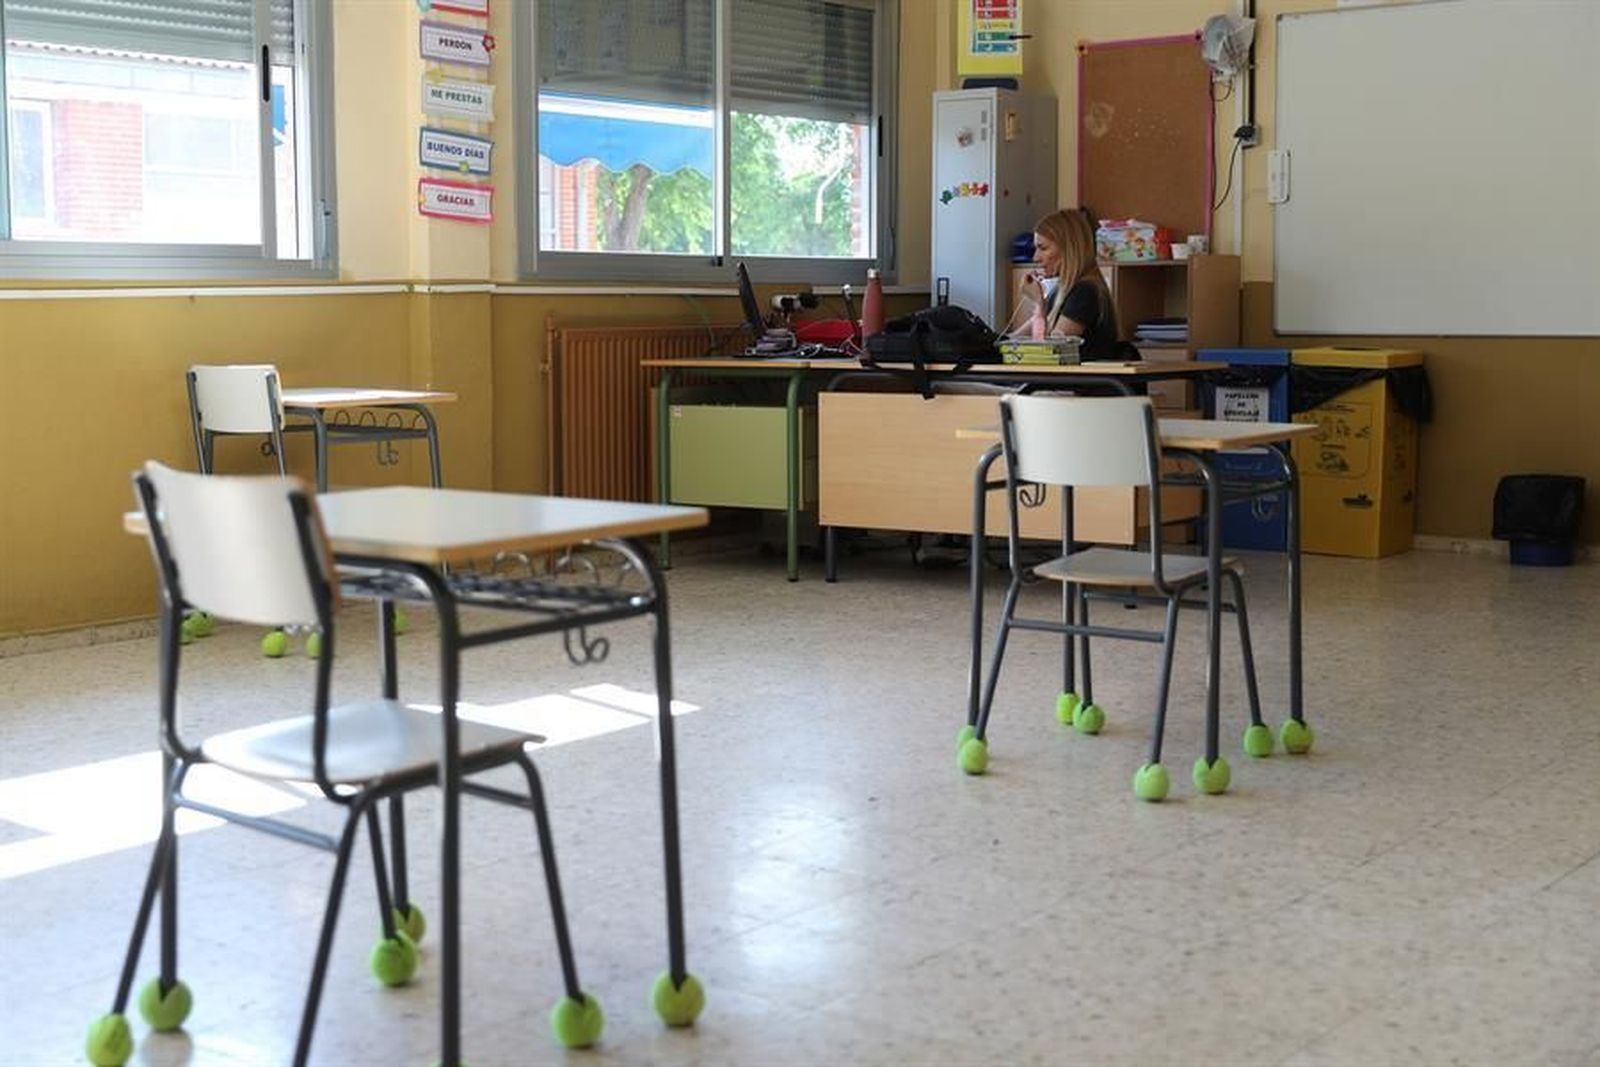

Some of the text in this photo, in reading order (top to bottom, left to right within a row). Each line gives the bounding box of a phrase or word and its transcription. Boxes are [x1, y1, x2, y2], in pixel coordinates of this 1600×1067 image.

[445, 91, 483, 105] PRESTAS
[427, 142, 463, 156] BUENOS
[436, 193, 475, 206] GRACIAS
